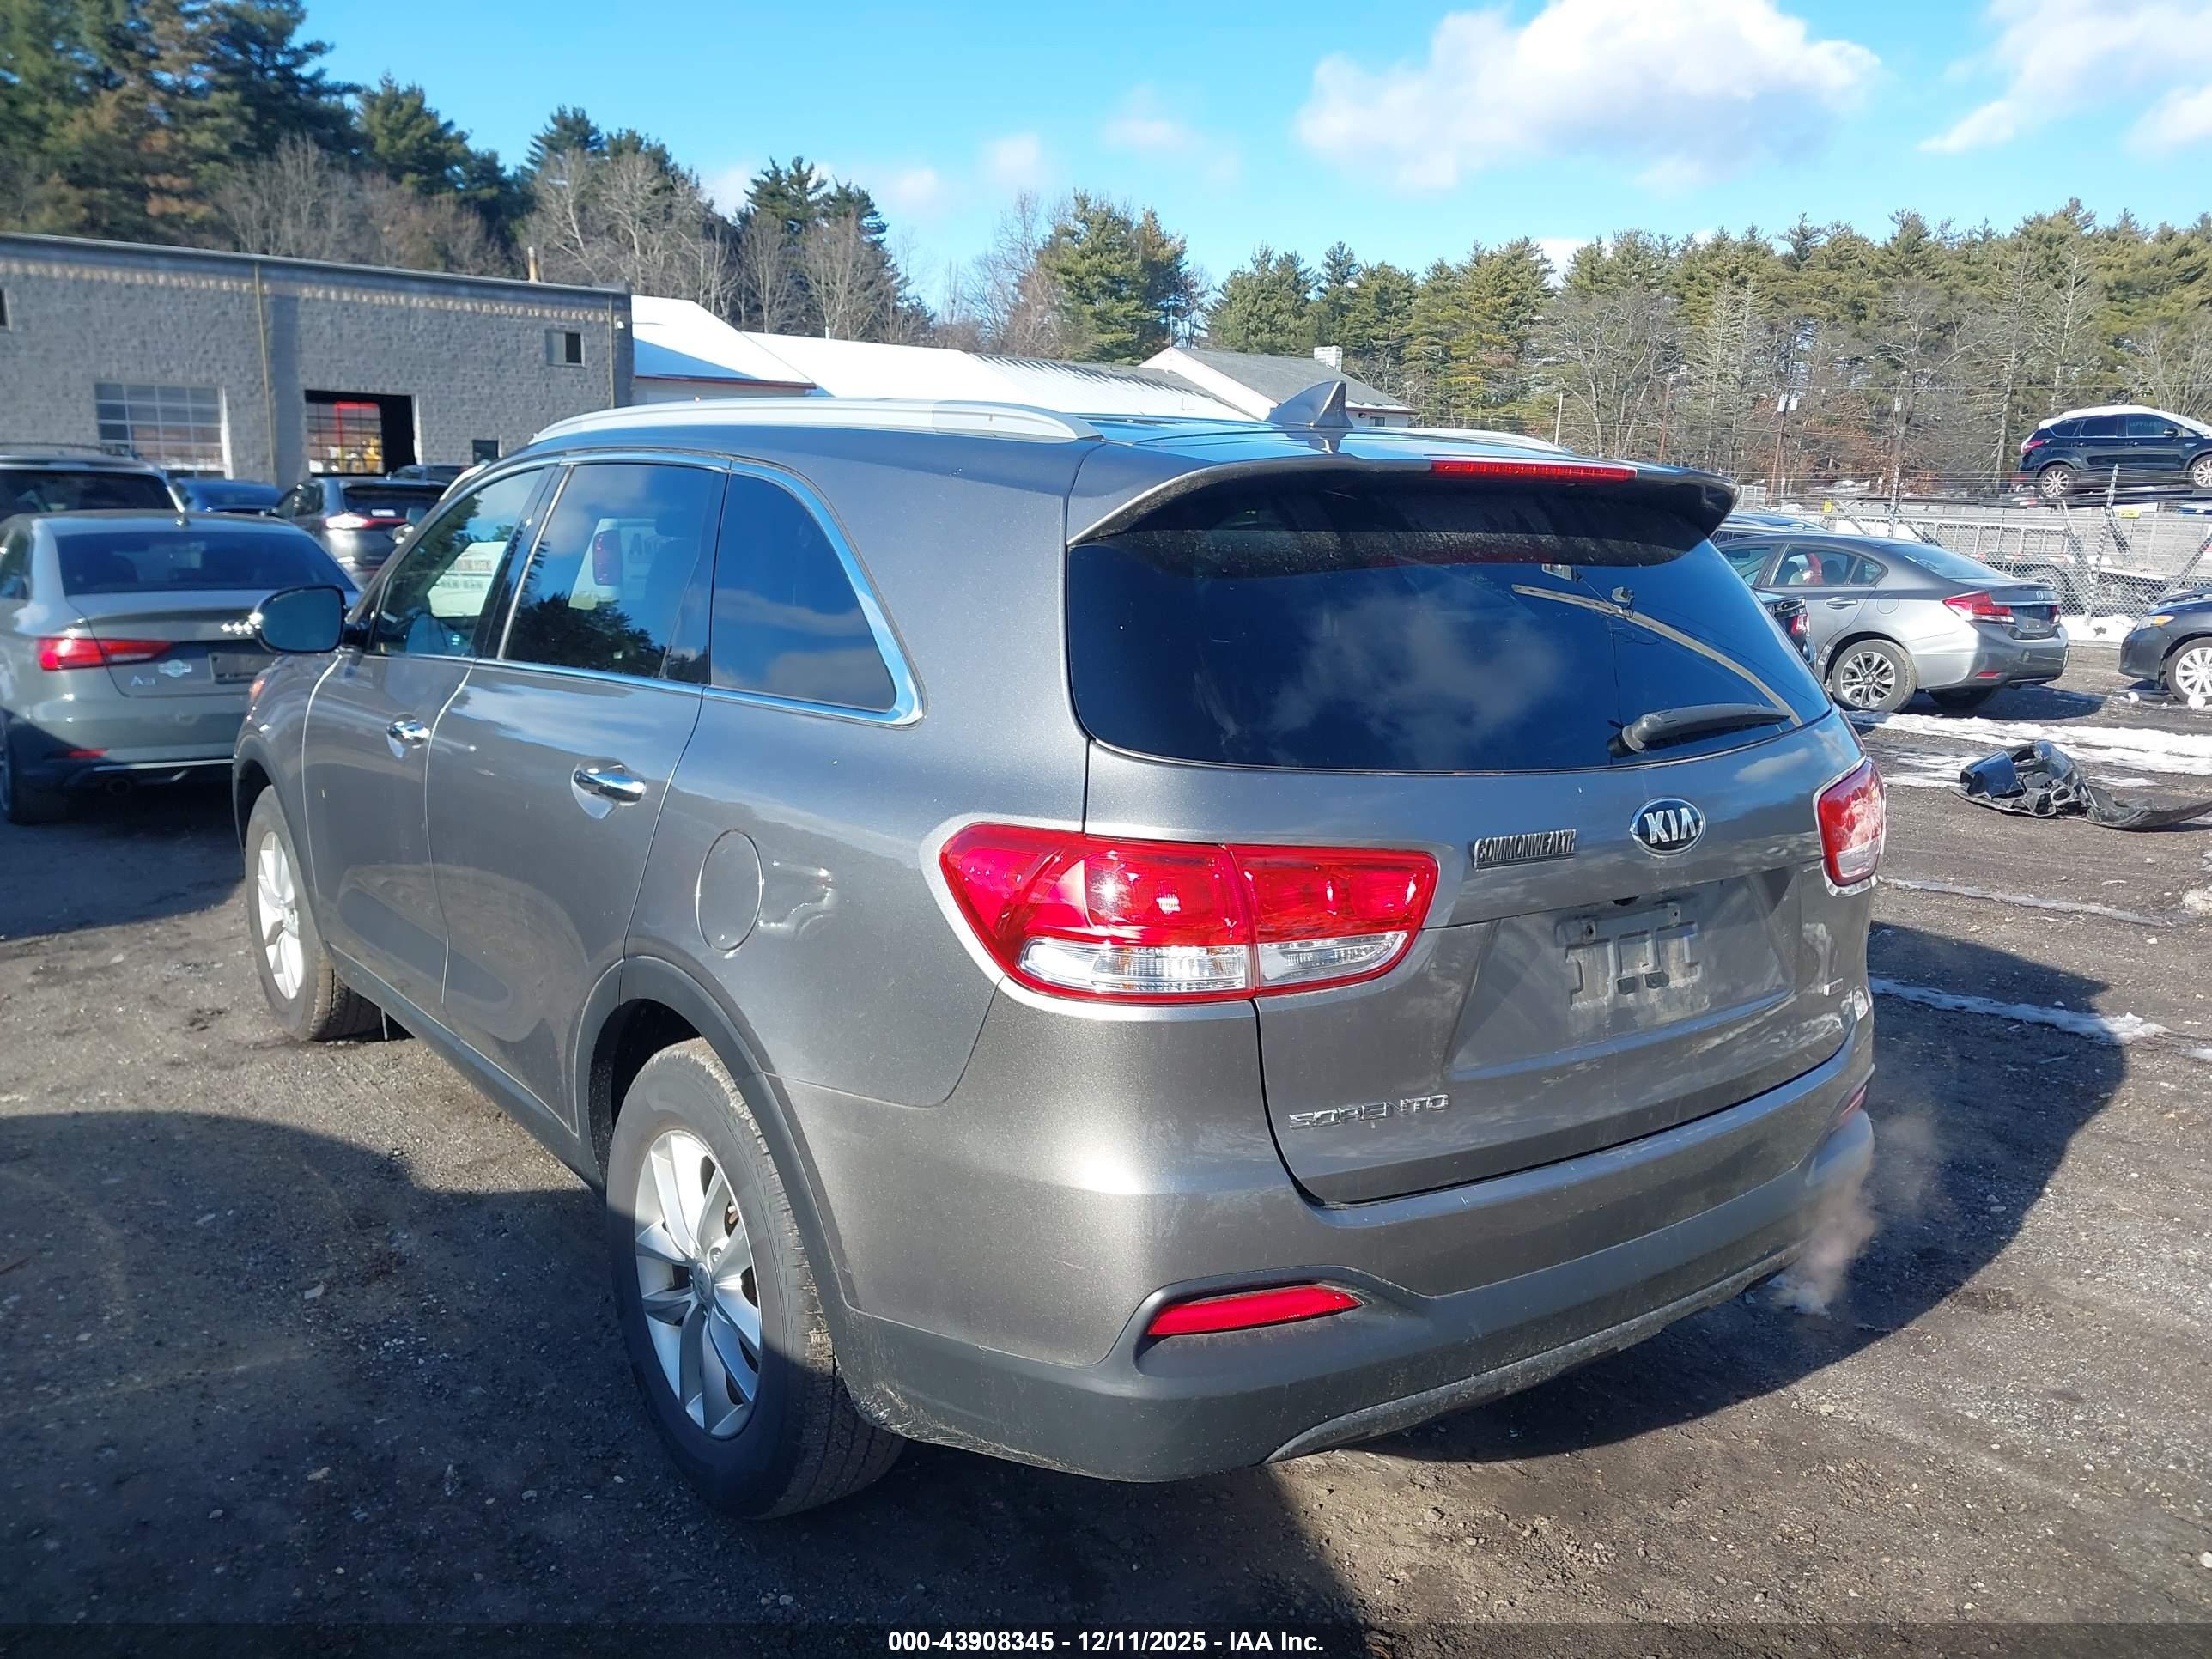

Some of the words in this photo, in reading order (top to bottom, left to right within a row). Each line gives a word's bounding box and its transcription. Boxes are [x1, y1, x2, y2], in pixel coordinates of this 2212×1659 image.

[1644, 807, 1697, 844] KIA
[1474, 829, 1577, 866] COMMONWEALTH
[1289, 1093, 1450, 1130] SORENTO
